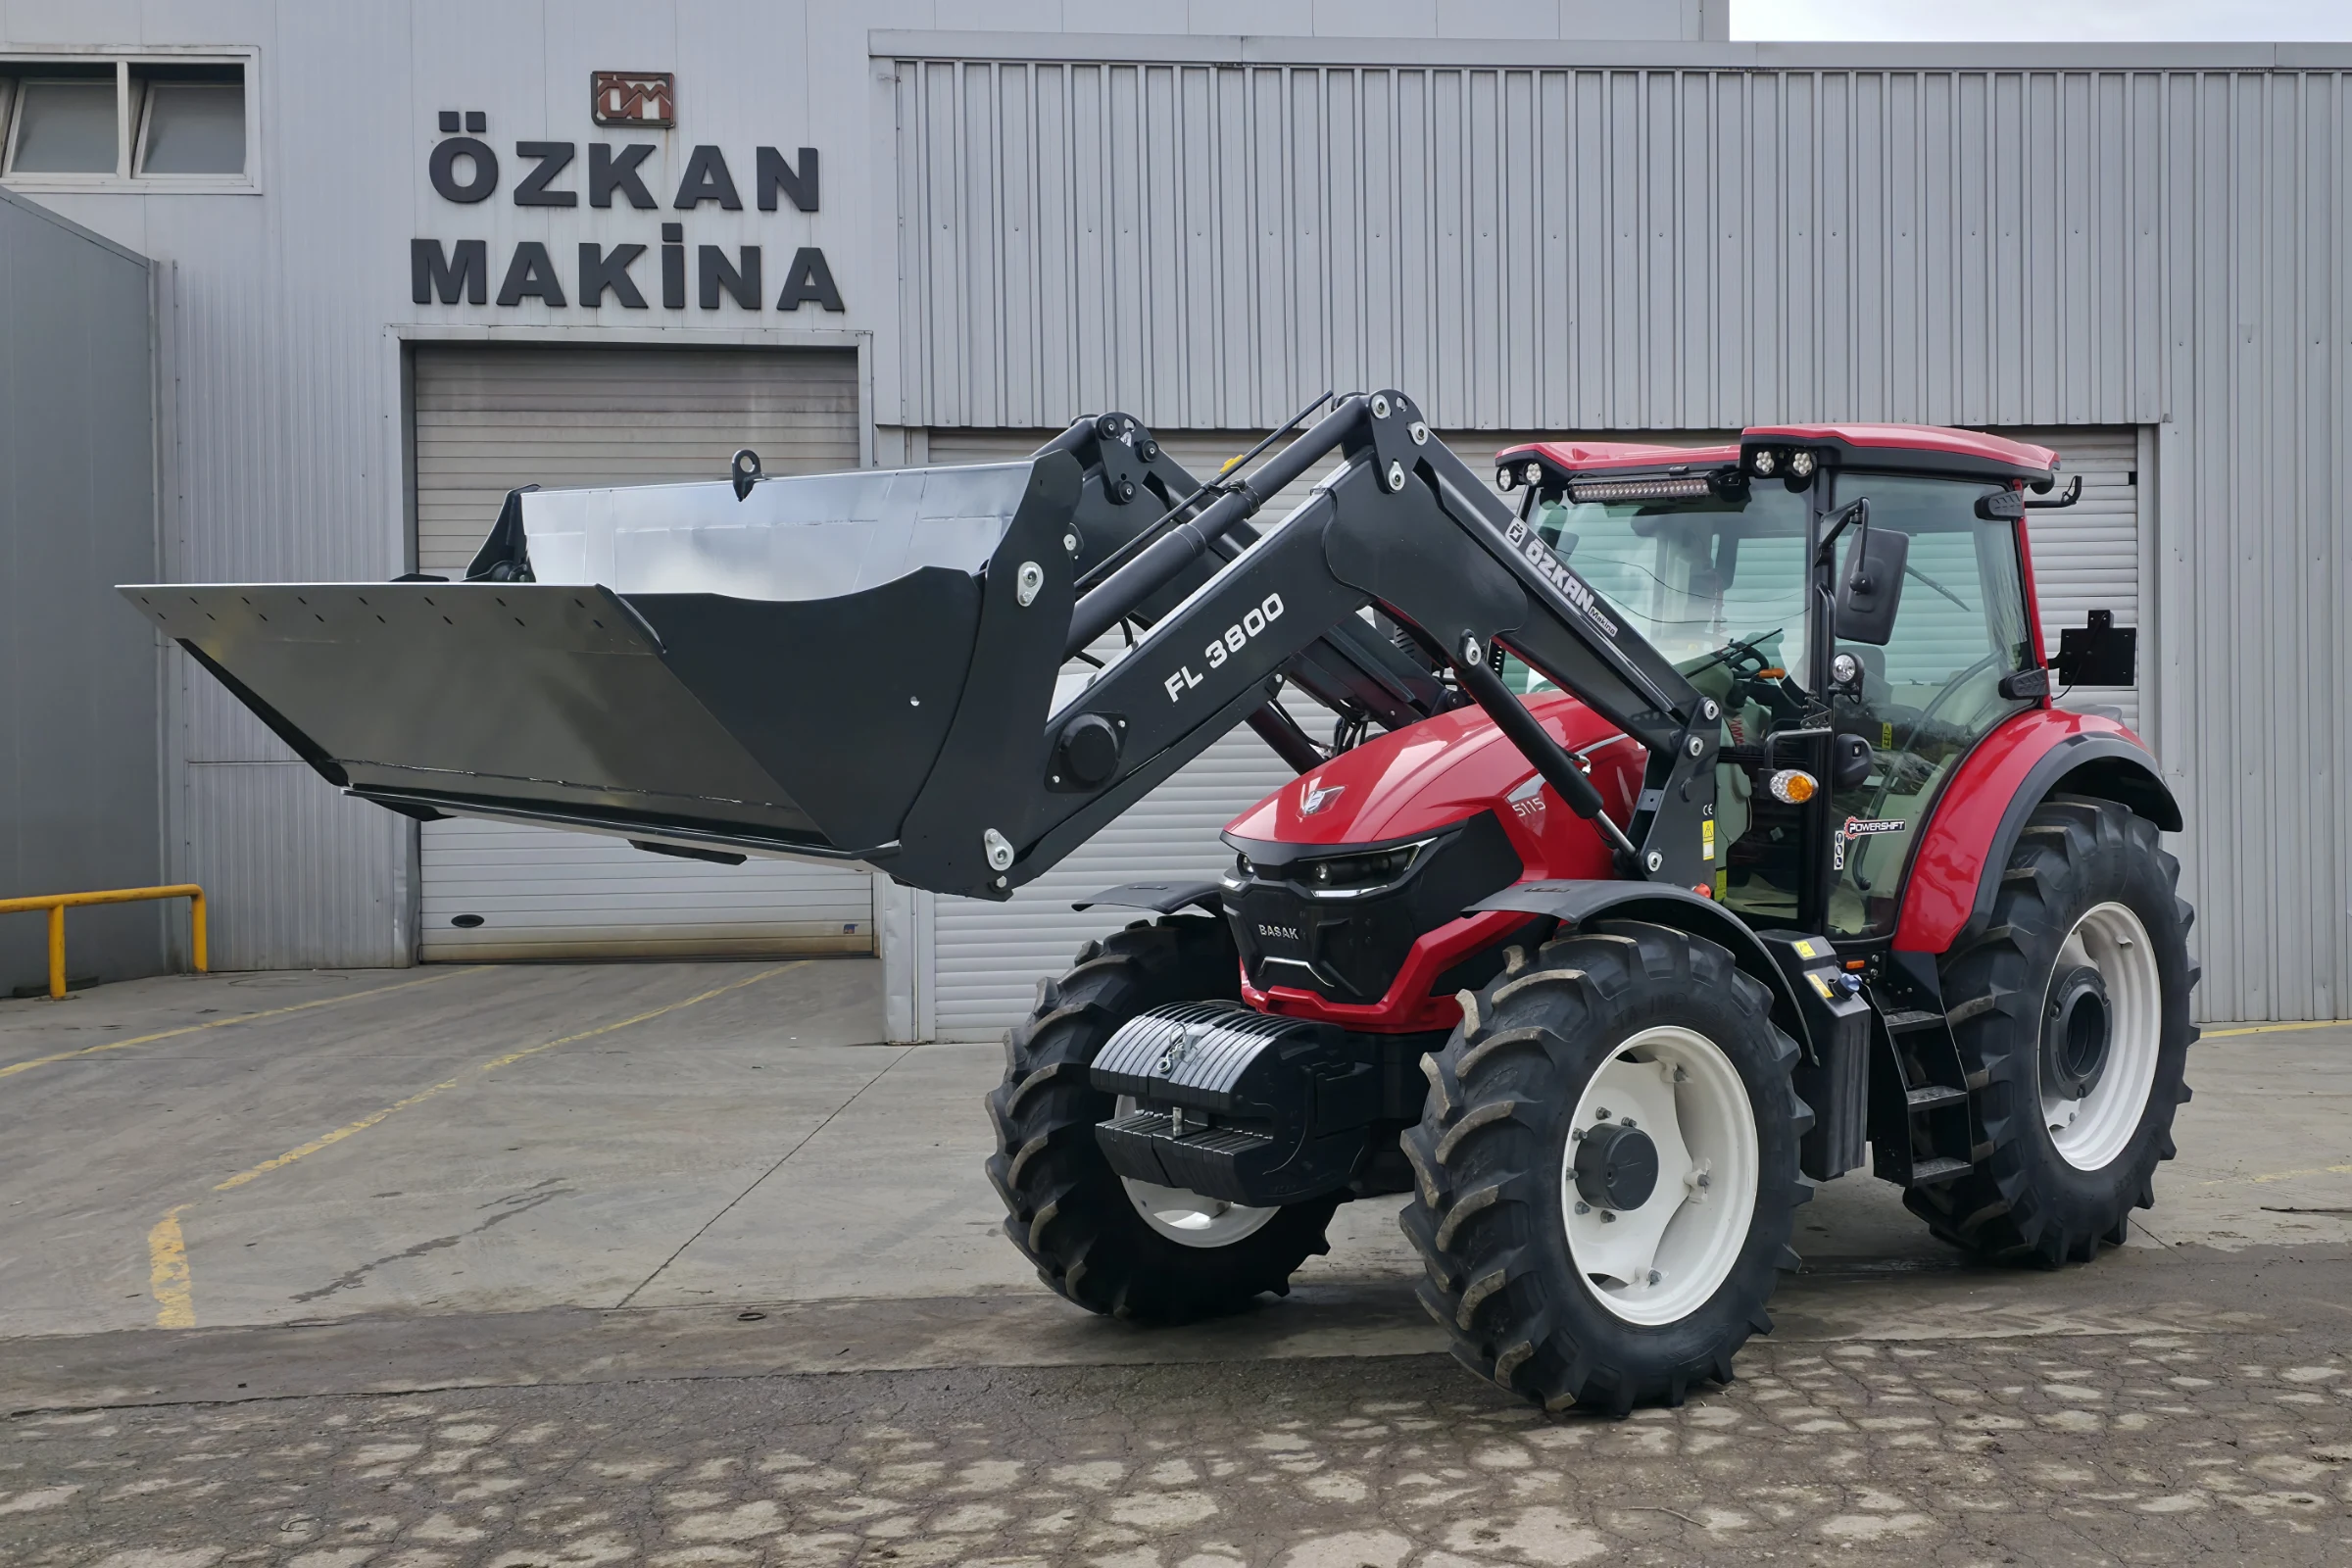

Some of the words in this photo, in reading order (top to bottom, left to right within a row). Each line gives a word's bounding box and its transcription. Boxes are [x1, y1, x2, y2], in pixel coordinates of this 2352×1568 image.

[428, 111, 819, 212] ÖZKAN
[410, 222, 846, 313] MAKİNA
[1525, 538, 1594, 613] ÖZKAN
[1164, 665, 1204, 703] FL
[1204, 592, 1285, 669] 3800
[1512, 797, 1546, 817] 5115
[1849, 821, 1905, 834] POWERSHIFT
[1258, 924, 1299, 940] BASAK
